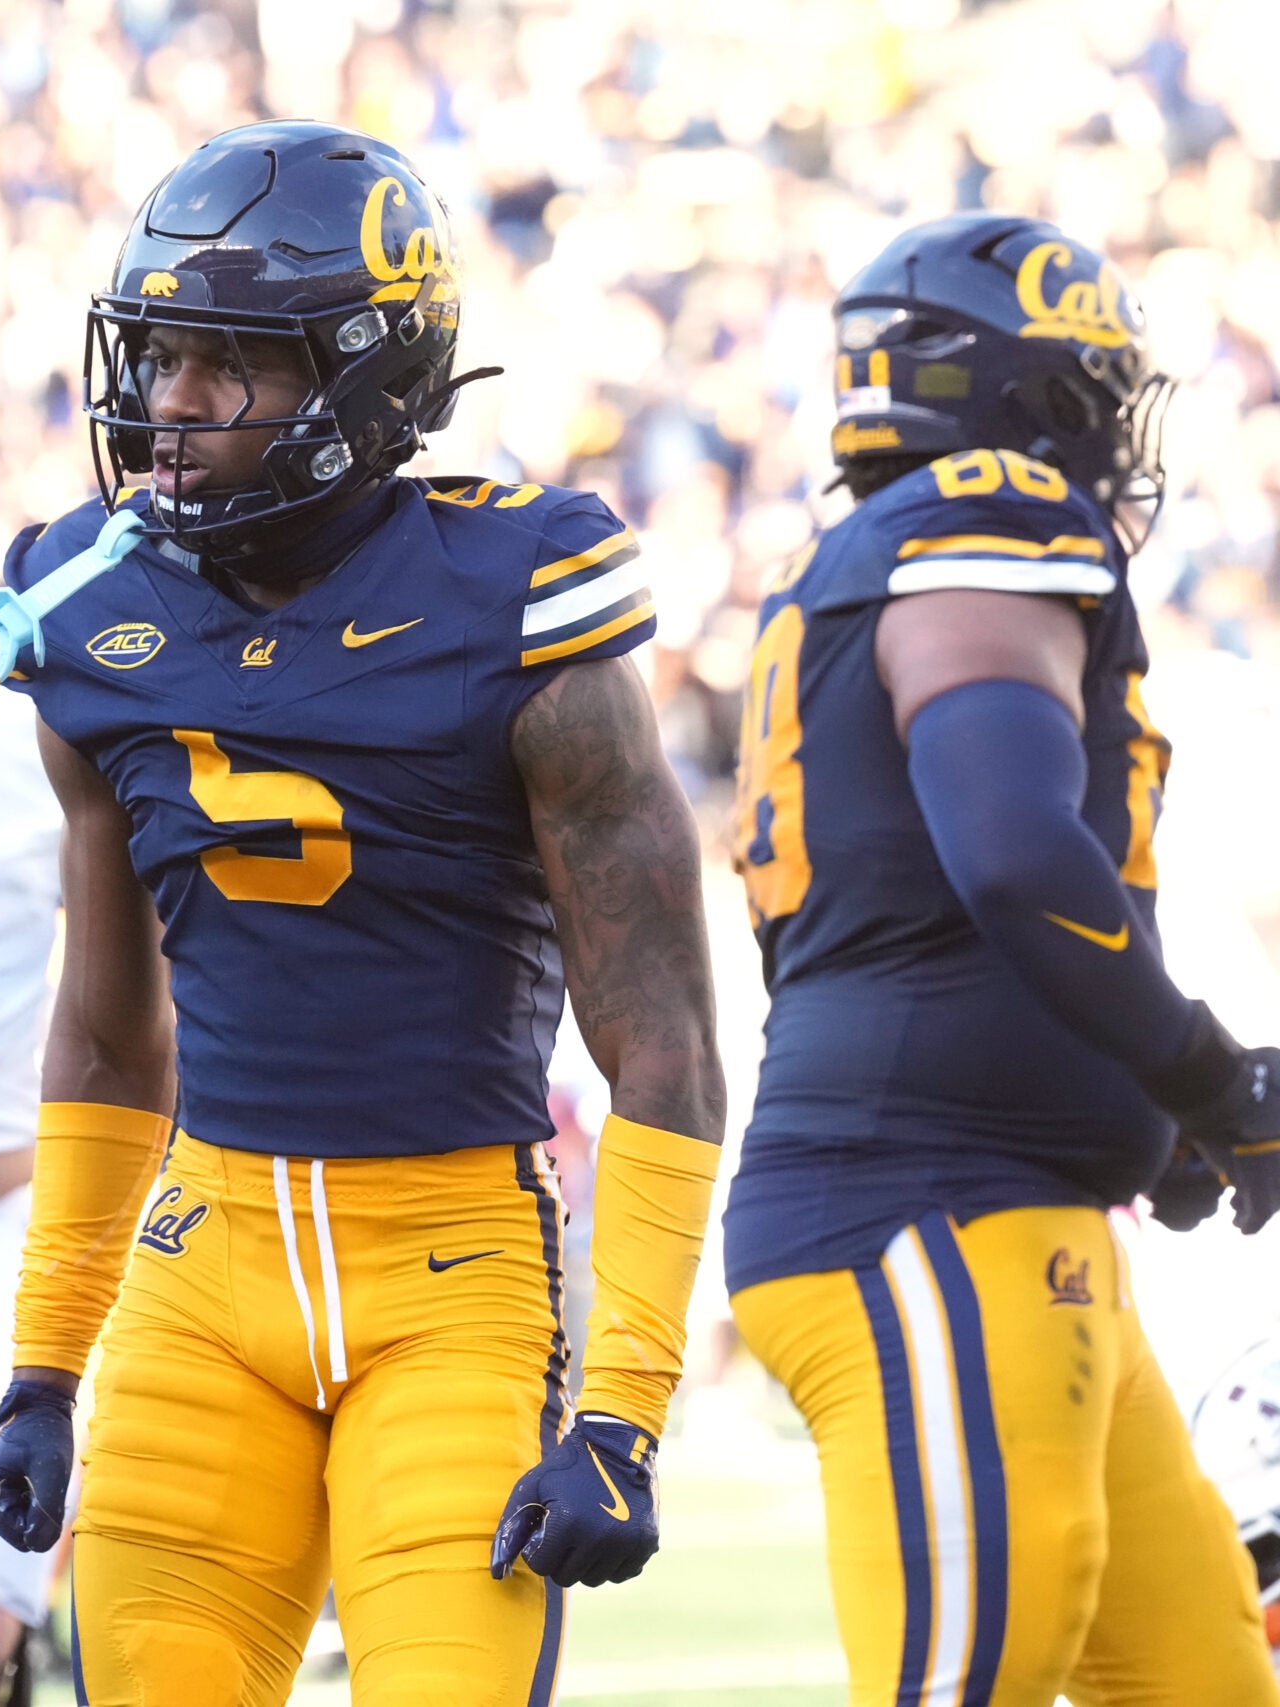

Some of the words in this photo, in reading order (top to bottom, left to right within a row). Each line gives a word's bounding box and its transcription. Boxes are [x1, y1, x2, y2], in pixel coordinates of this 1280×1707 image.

[360, 176, 459, 304] Cal
[1016, 241, 1131, 348] Cal
[96, 630, 158, 651] ACC
[239, 637, 277, 667] Cal
[172, 729, 353, 906] 5
[138, 1185, 207, 1255] Cal
[1047, 1245, 1094, 1306] Cal
